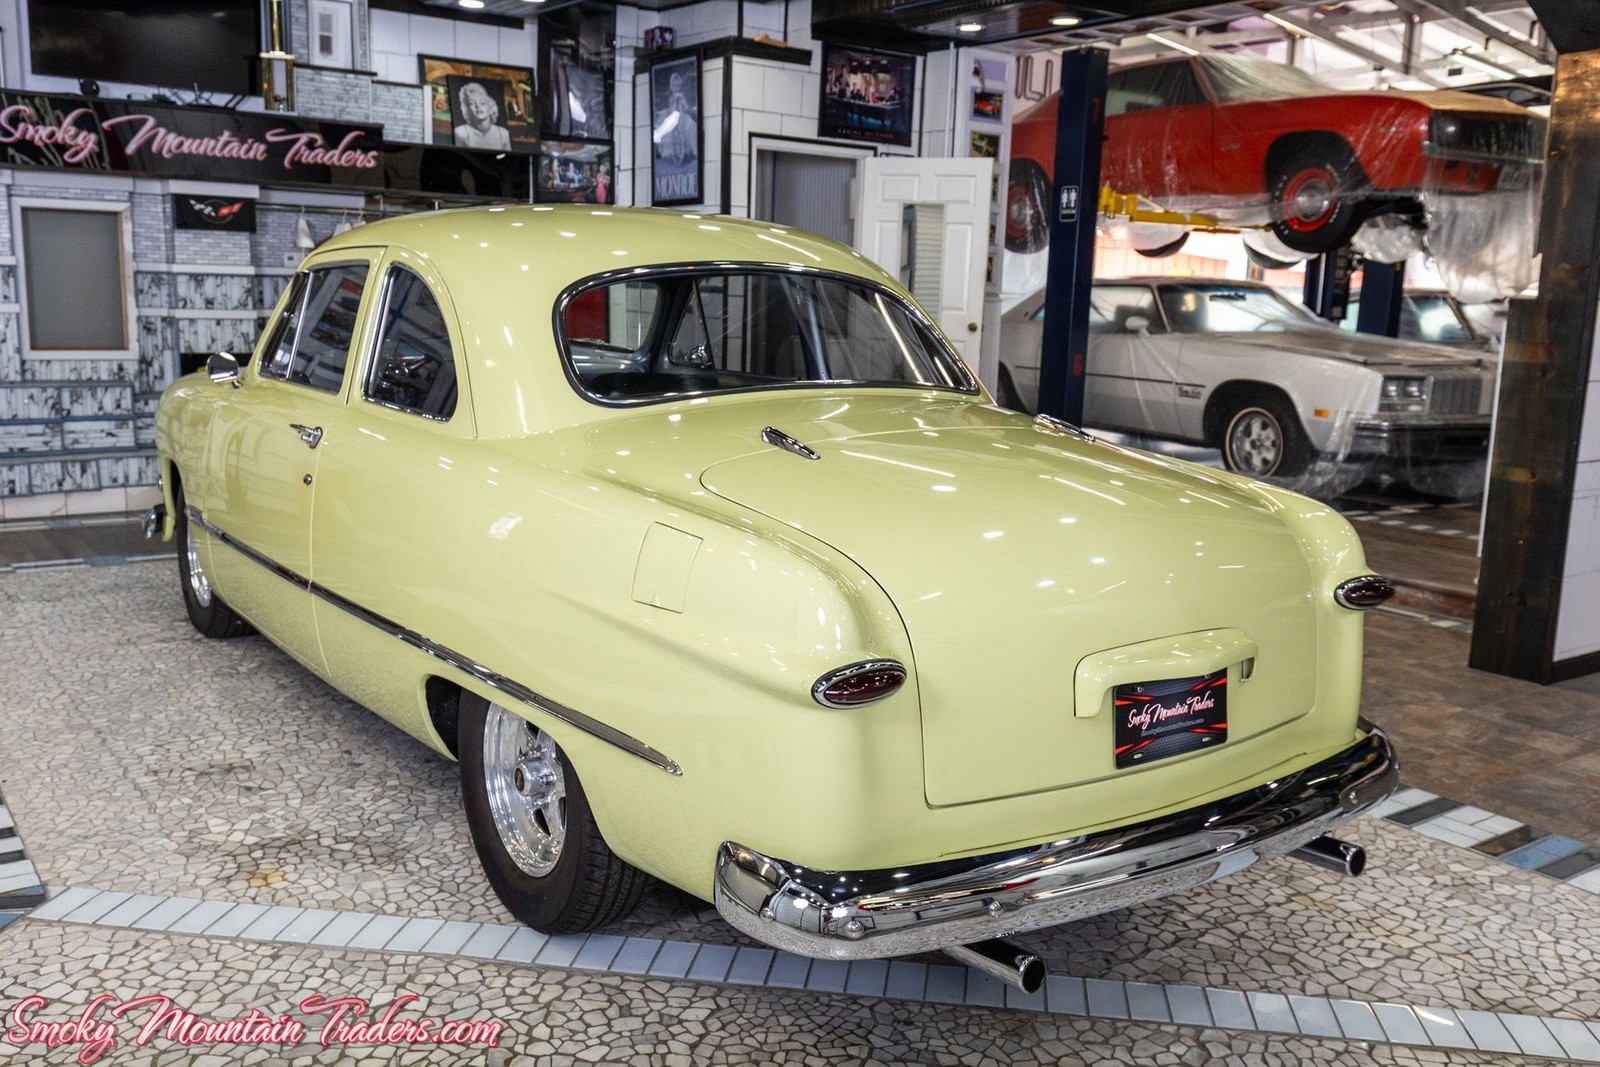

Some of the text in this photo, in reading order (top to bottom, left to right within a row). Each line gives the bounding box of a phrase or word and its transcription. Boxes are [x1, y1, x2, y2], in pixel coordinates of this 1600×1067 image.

[0, 105, 379, 170] Smoky Mountain Traders
[656, 173, 697, 197] MONROE
[1128, 704, 1151, 729] Smoky
[1149, 703, 1188, 723] Mountain
[1187, 691, 1214, 715] Traders
